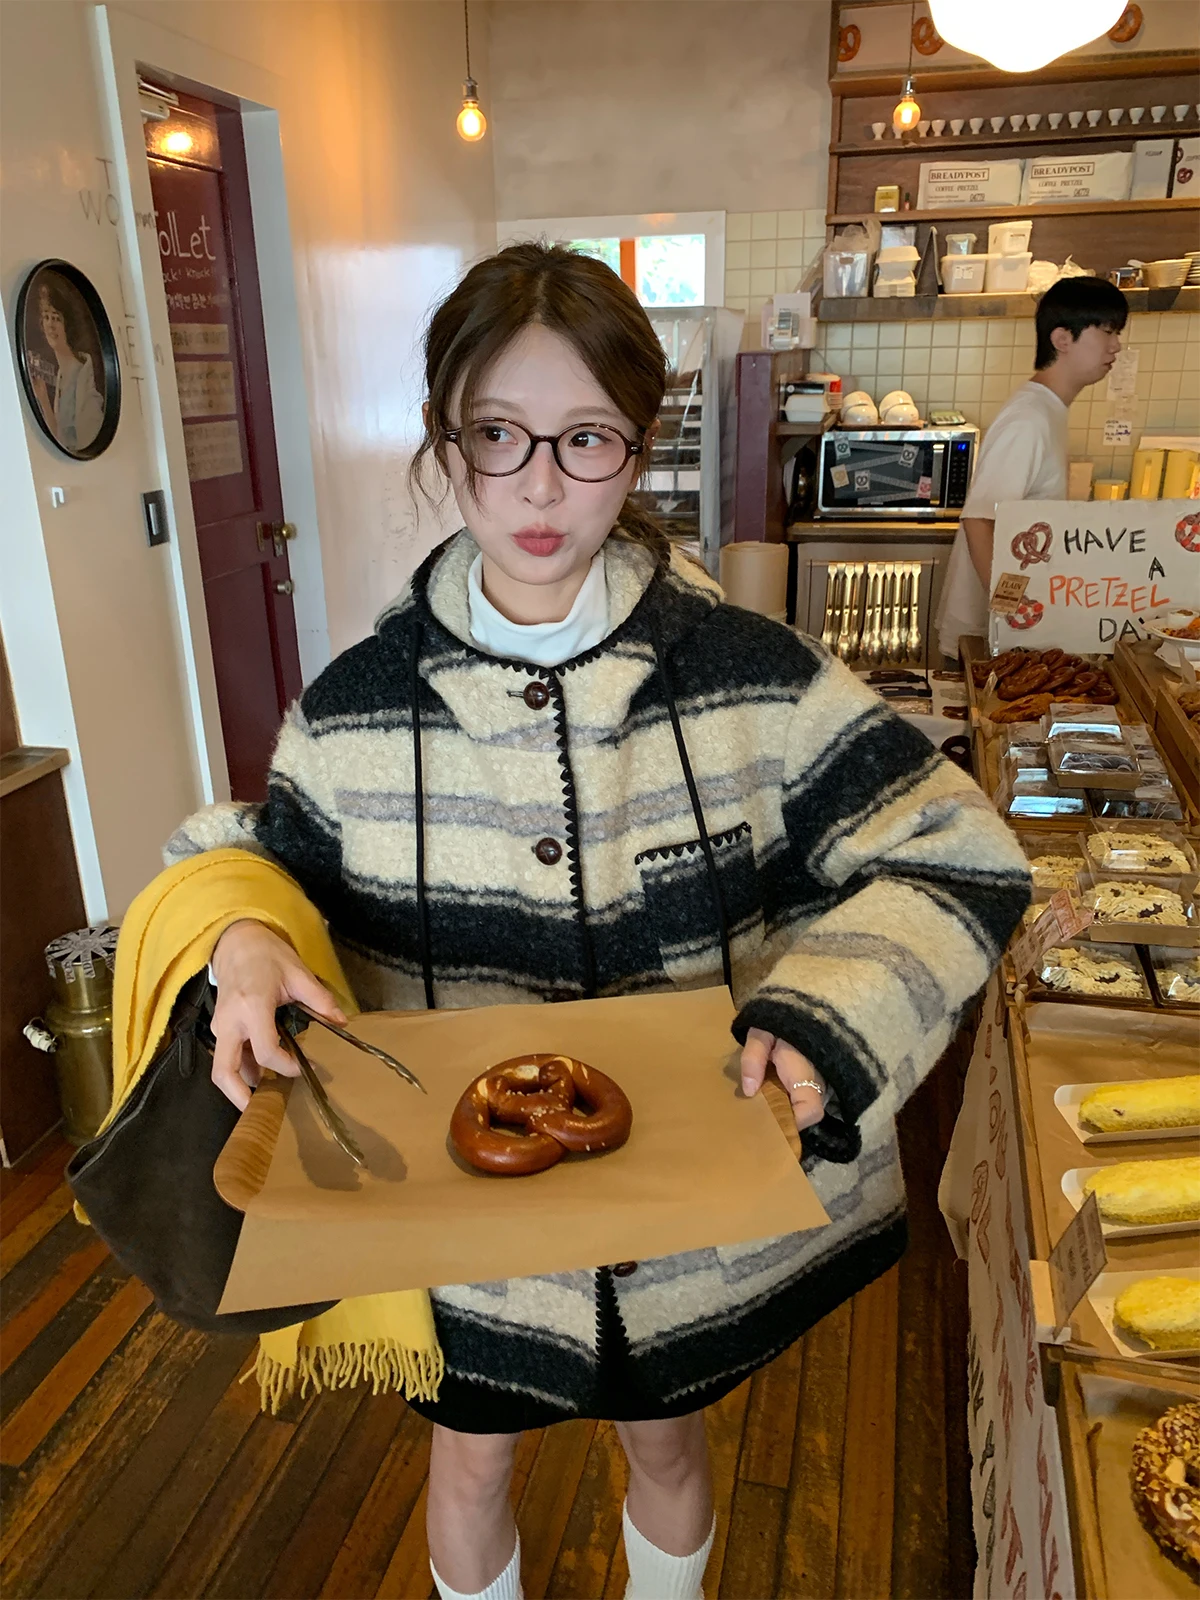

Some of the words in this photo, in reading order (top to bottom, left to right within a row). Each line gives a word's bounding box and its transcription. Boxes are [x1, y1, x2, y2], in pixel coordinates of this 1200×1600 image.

[931, 171, 987, 180] BREADYPOST
[1033, 165, 1091, 176] BREADYPOST
[957, 184, 979, 192] PRETZEL
[1064, 527, 1146, 554] HAVE
[1148, 557, 1166, 581] A
[1001, 580, 1023, 590] PLAIN
[1049, 575, 1171, 613] PRETZEL
